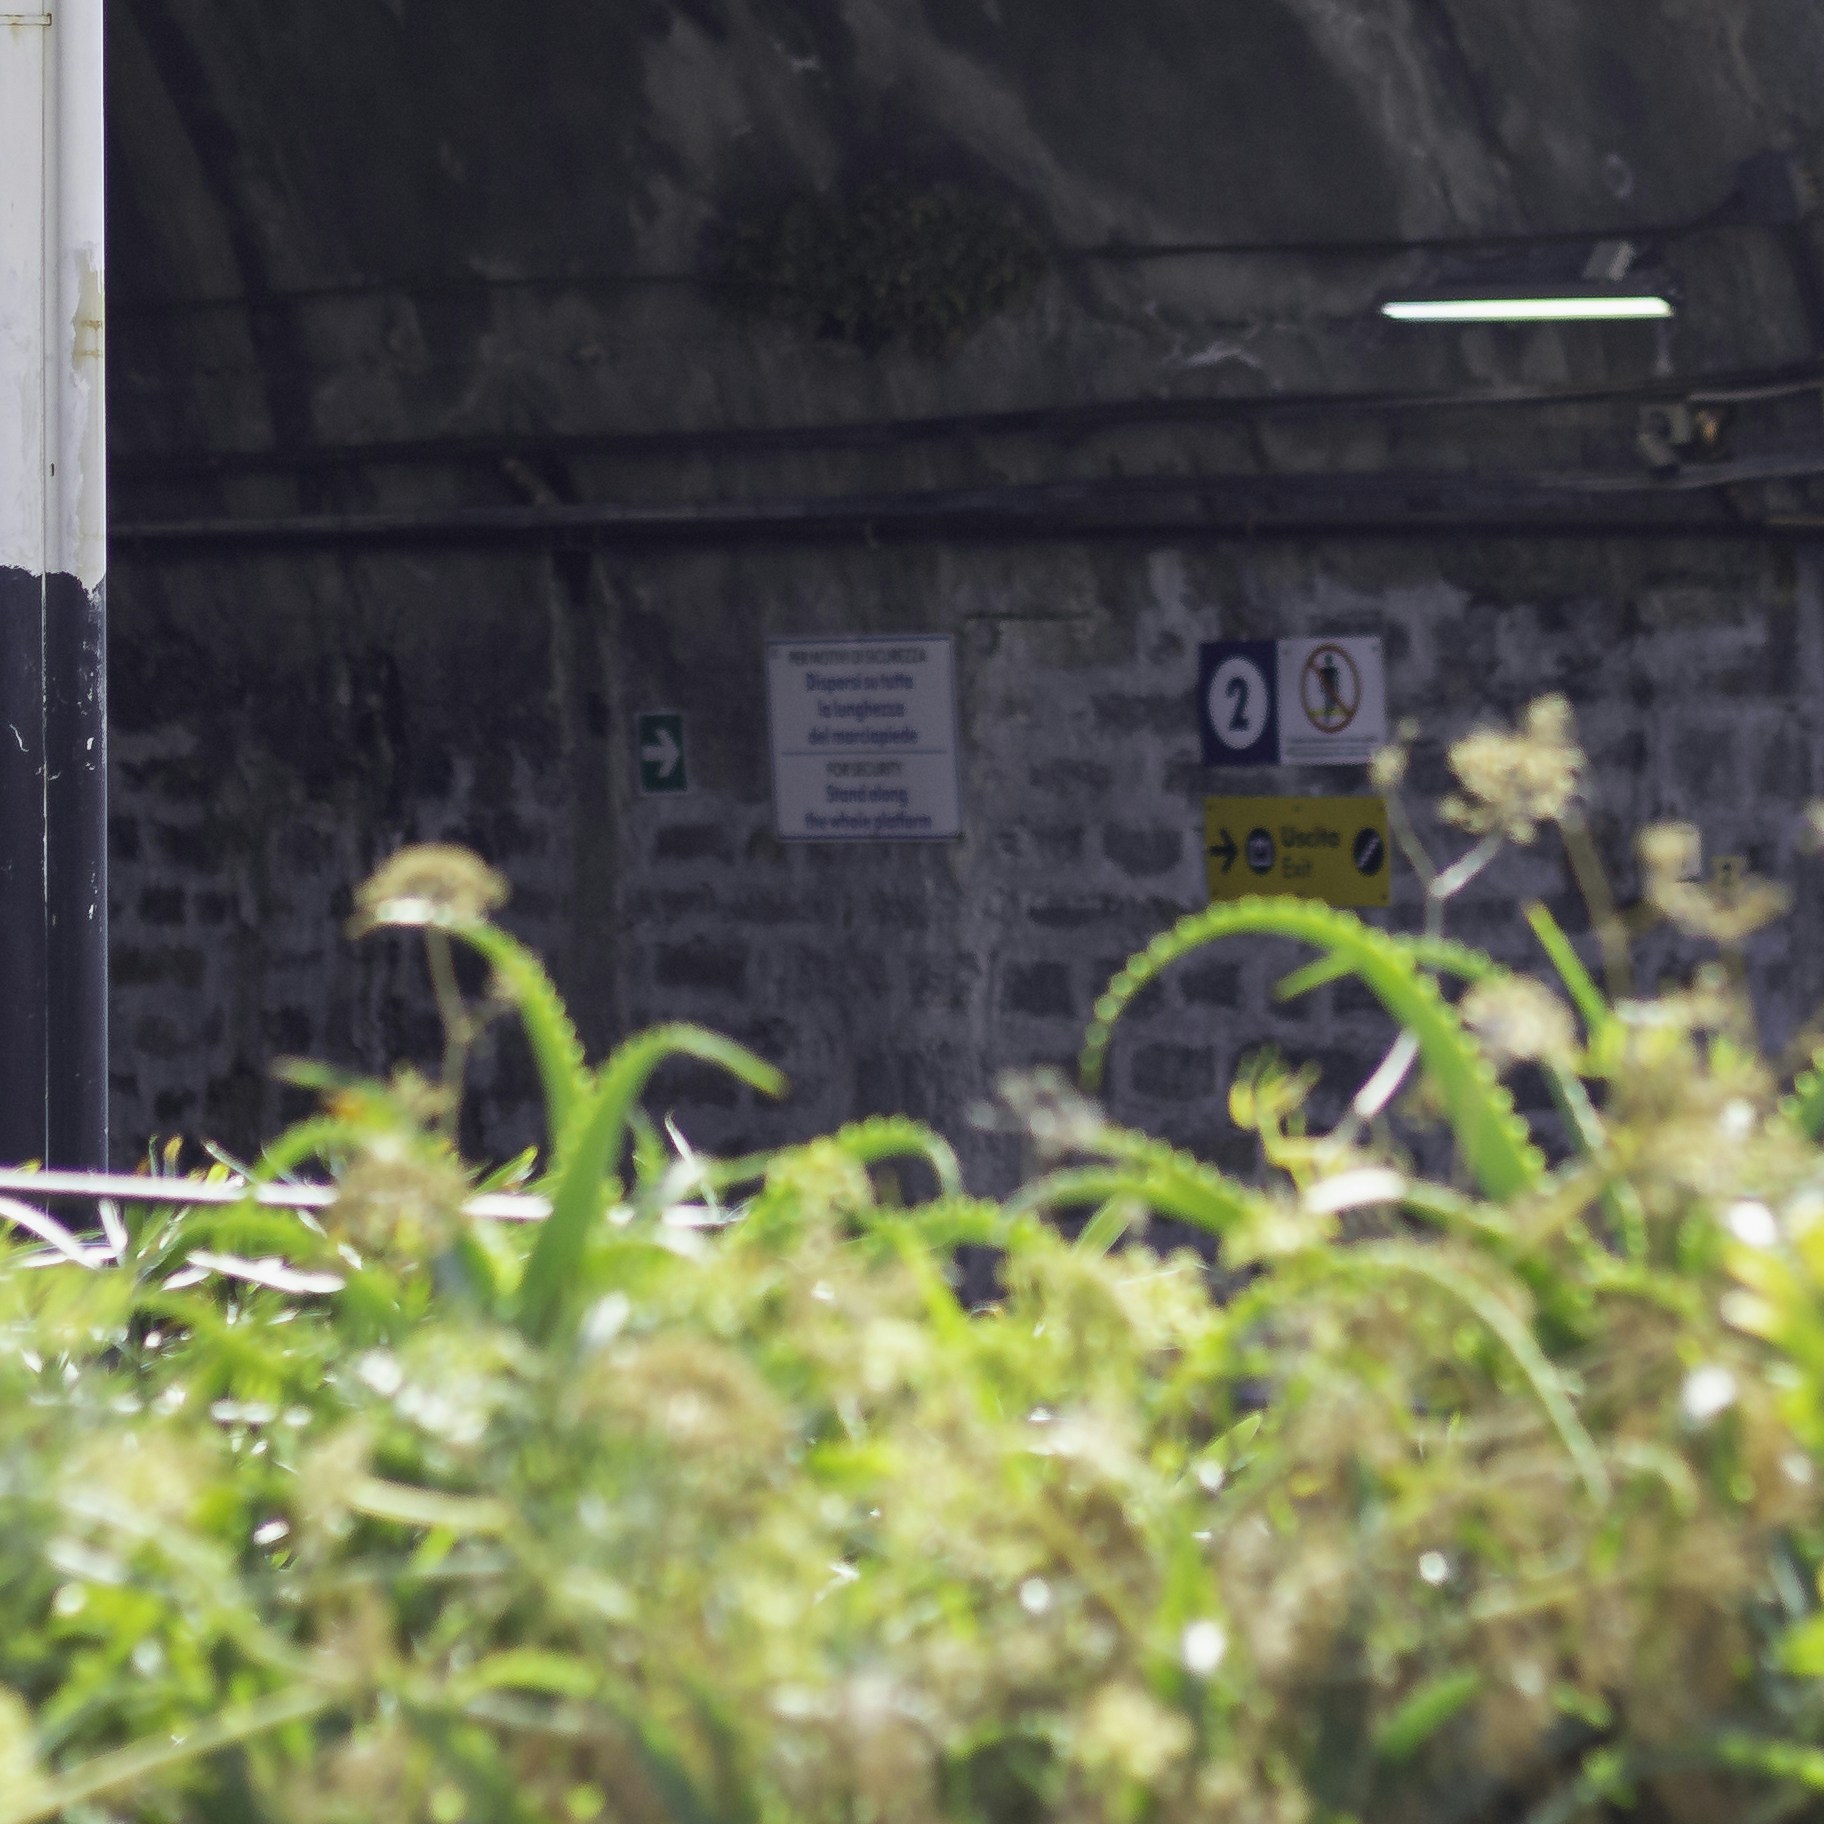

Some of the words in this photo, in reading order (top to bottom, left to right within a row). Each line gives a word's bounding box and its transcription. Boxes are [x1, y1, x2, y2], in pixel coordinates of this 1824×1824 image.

[834, 700, 905, 722] lunghezza
[1226, 676, 1250, 731] 2
[832, 728, 918, 747] marciapiede
[873, 810, 932, 831] platform
[1280, 826, 1341, 849] Uscita
[1282, 856, 1313, 878] Exit
